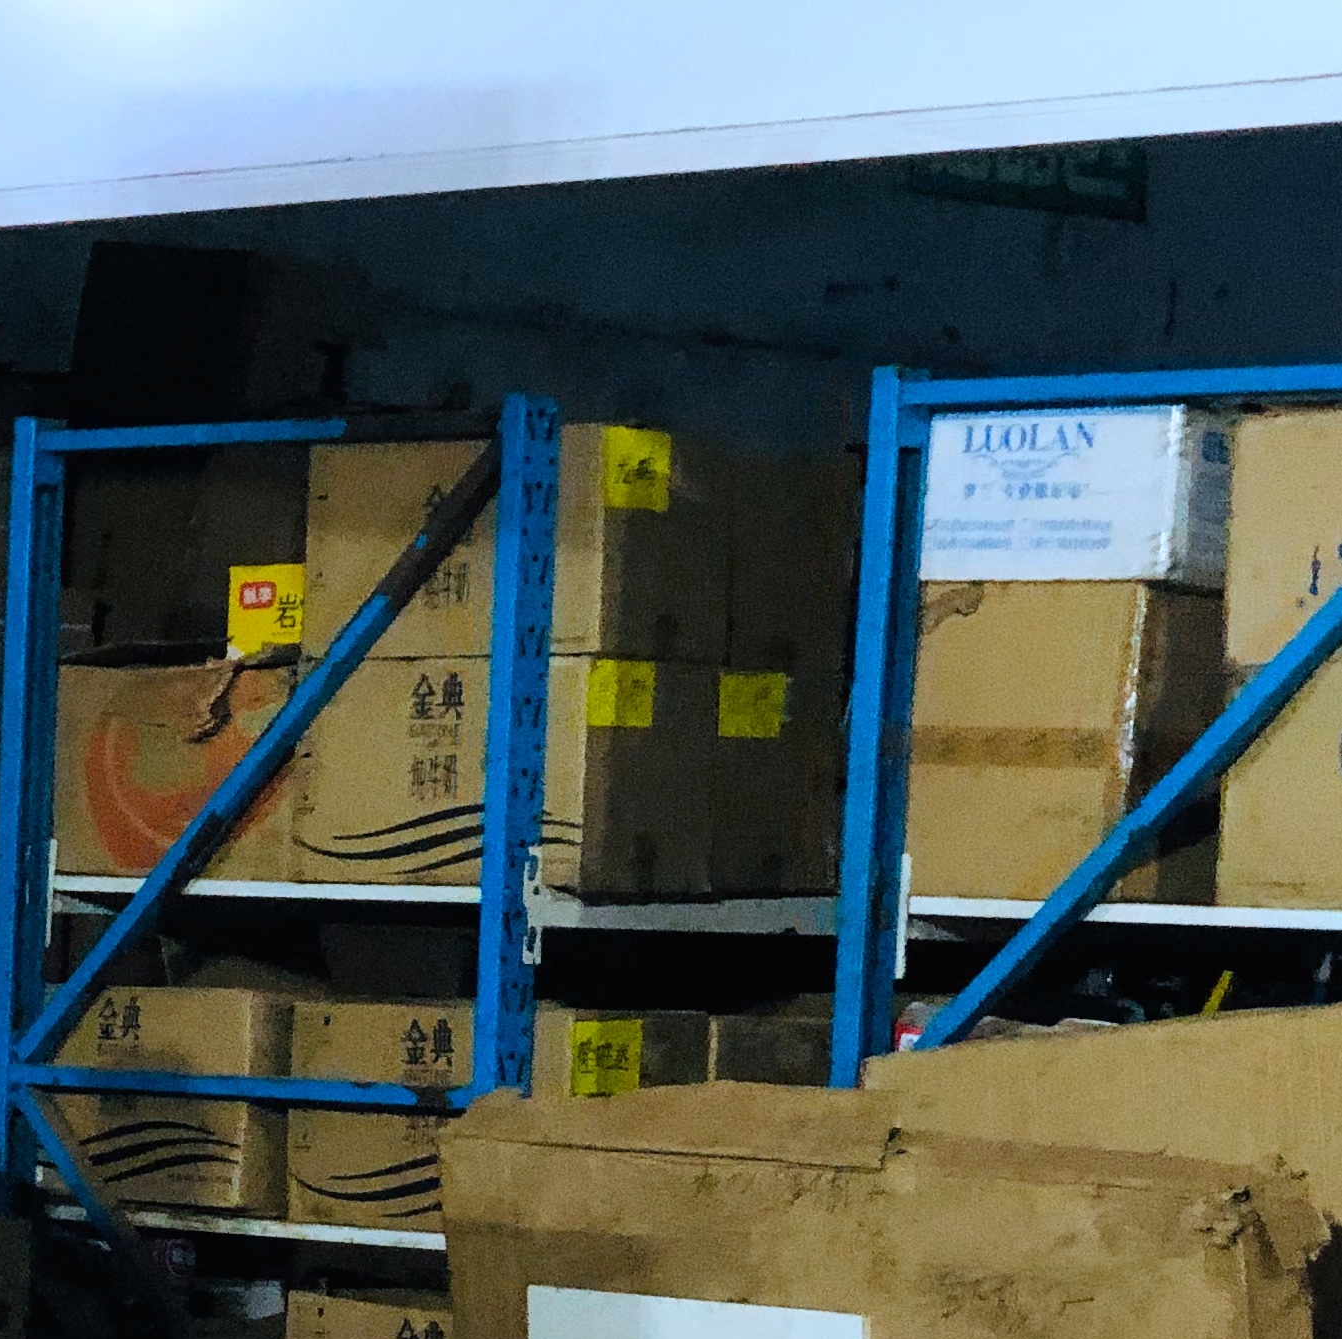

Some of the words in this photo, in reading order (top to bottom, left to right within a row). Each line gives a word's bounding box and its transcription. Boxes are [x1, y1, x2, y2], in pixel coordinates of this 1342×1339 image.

[964, 422, 1094, 453] LUOLAN
[274, 592, 300, 628] 岩
[412, 673, 464, 720] 金典
[98, 997, 142, 1041] 金典
[400, 1019, 455, 1067] 金典
